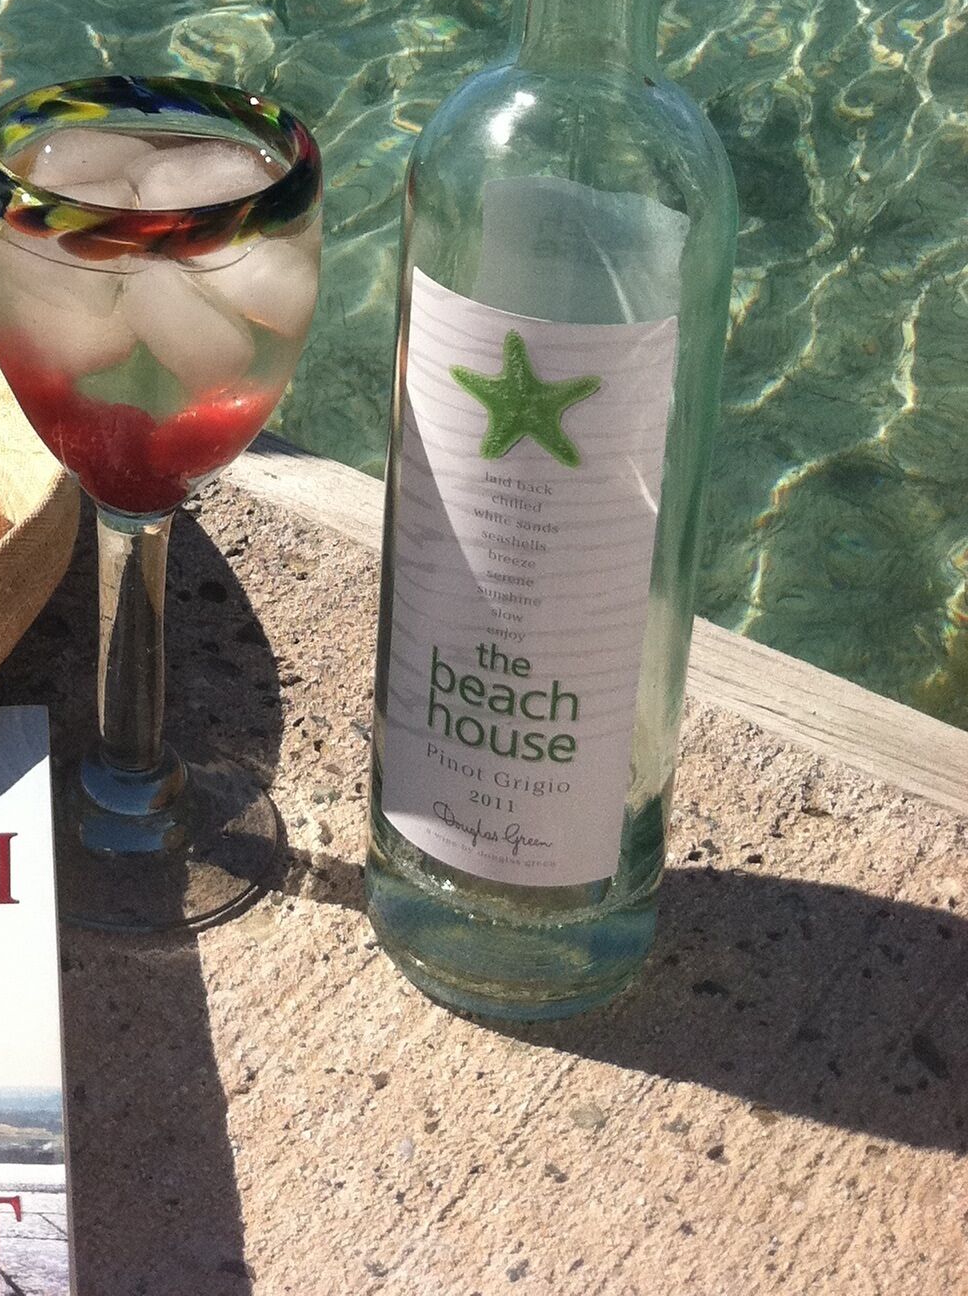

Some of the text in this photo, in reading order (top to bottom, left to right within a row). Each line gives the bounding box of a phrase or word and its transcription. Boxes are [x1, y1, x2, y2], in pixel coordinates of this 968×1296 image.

[517, 479, 553, 496] back
[516, 519, 559, 534] sands
[488, 549, 536, 569] breeze
[476, 642, 531, 677] the
[431, 646, 580, 722] beach
[427, 687, 577, 763] house
[427, 742, 571, 797] Pinot Grigio
[469, 790, 515, 813] 2011
[433, 801, 553, 856] Douglas Green
